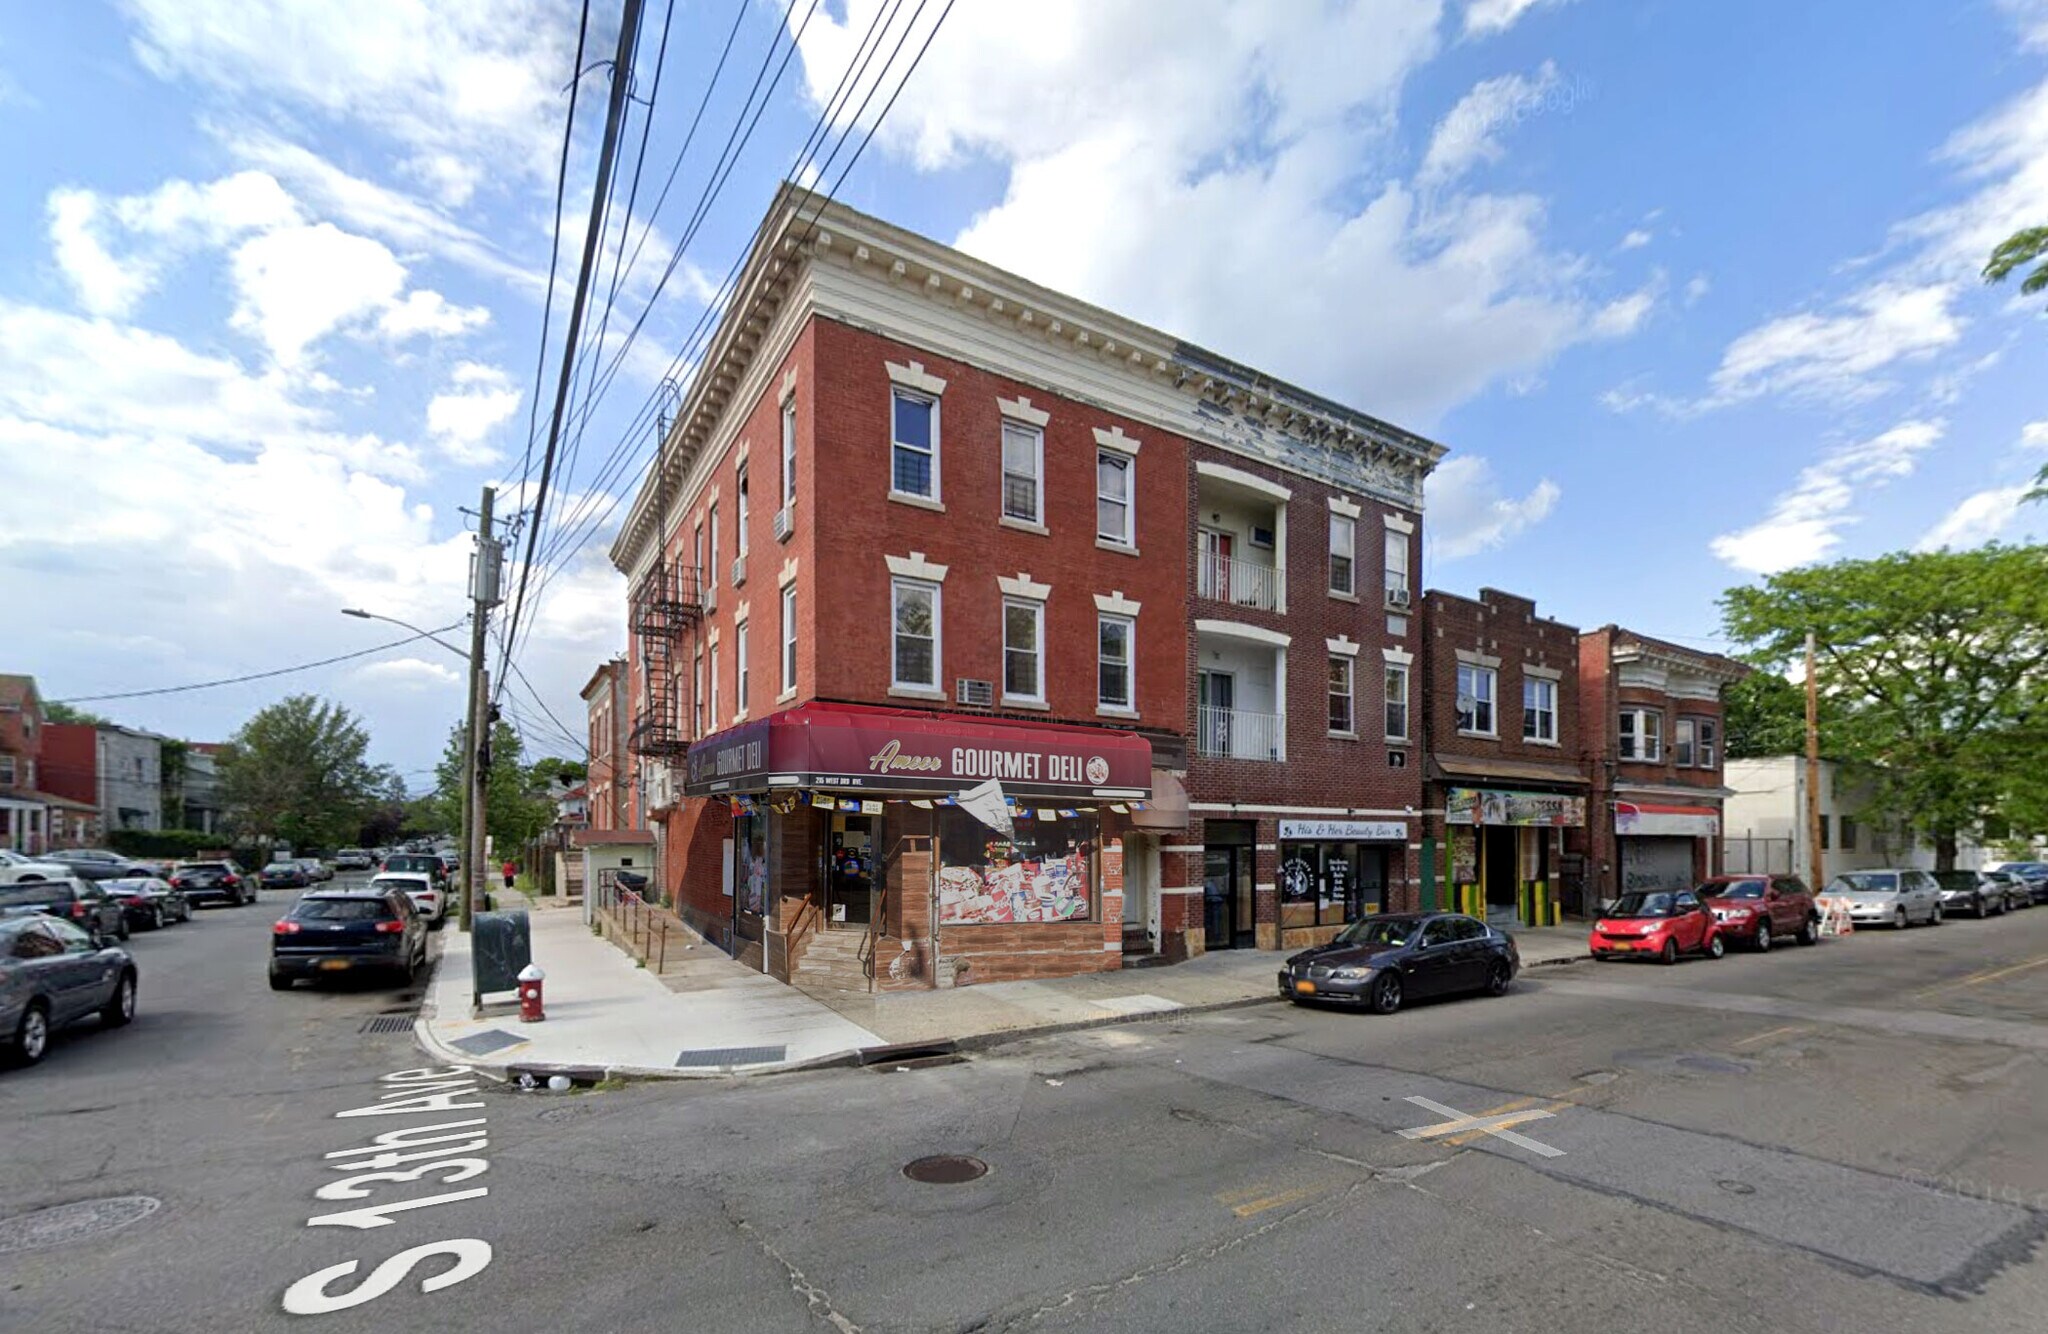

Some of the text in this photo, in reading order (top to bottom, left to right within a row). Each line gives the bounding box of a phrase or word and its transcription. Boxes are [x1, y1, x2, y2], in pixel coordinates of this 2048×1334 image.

[716, 744, 745, 776] GOURMET
[746, 740, 761, 770] DELI
[868, 739, 1083, 783] Ameer GOURMET DELI
[1327, 824, 1343, 836] Her
[1345, 824, 1373, 838] Beauty
